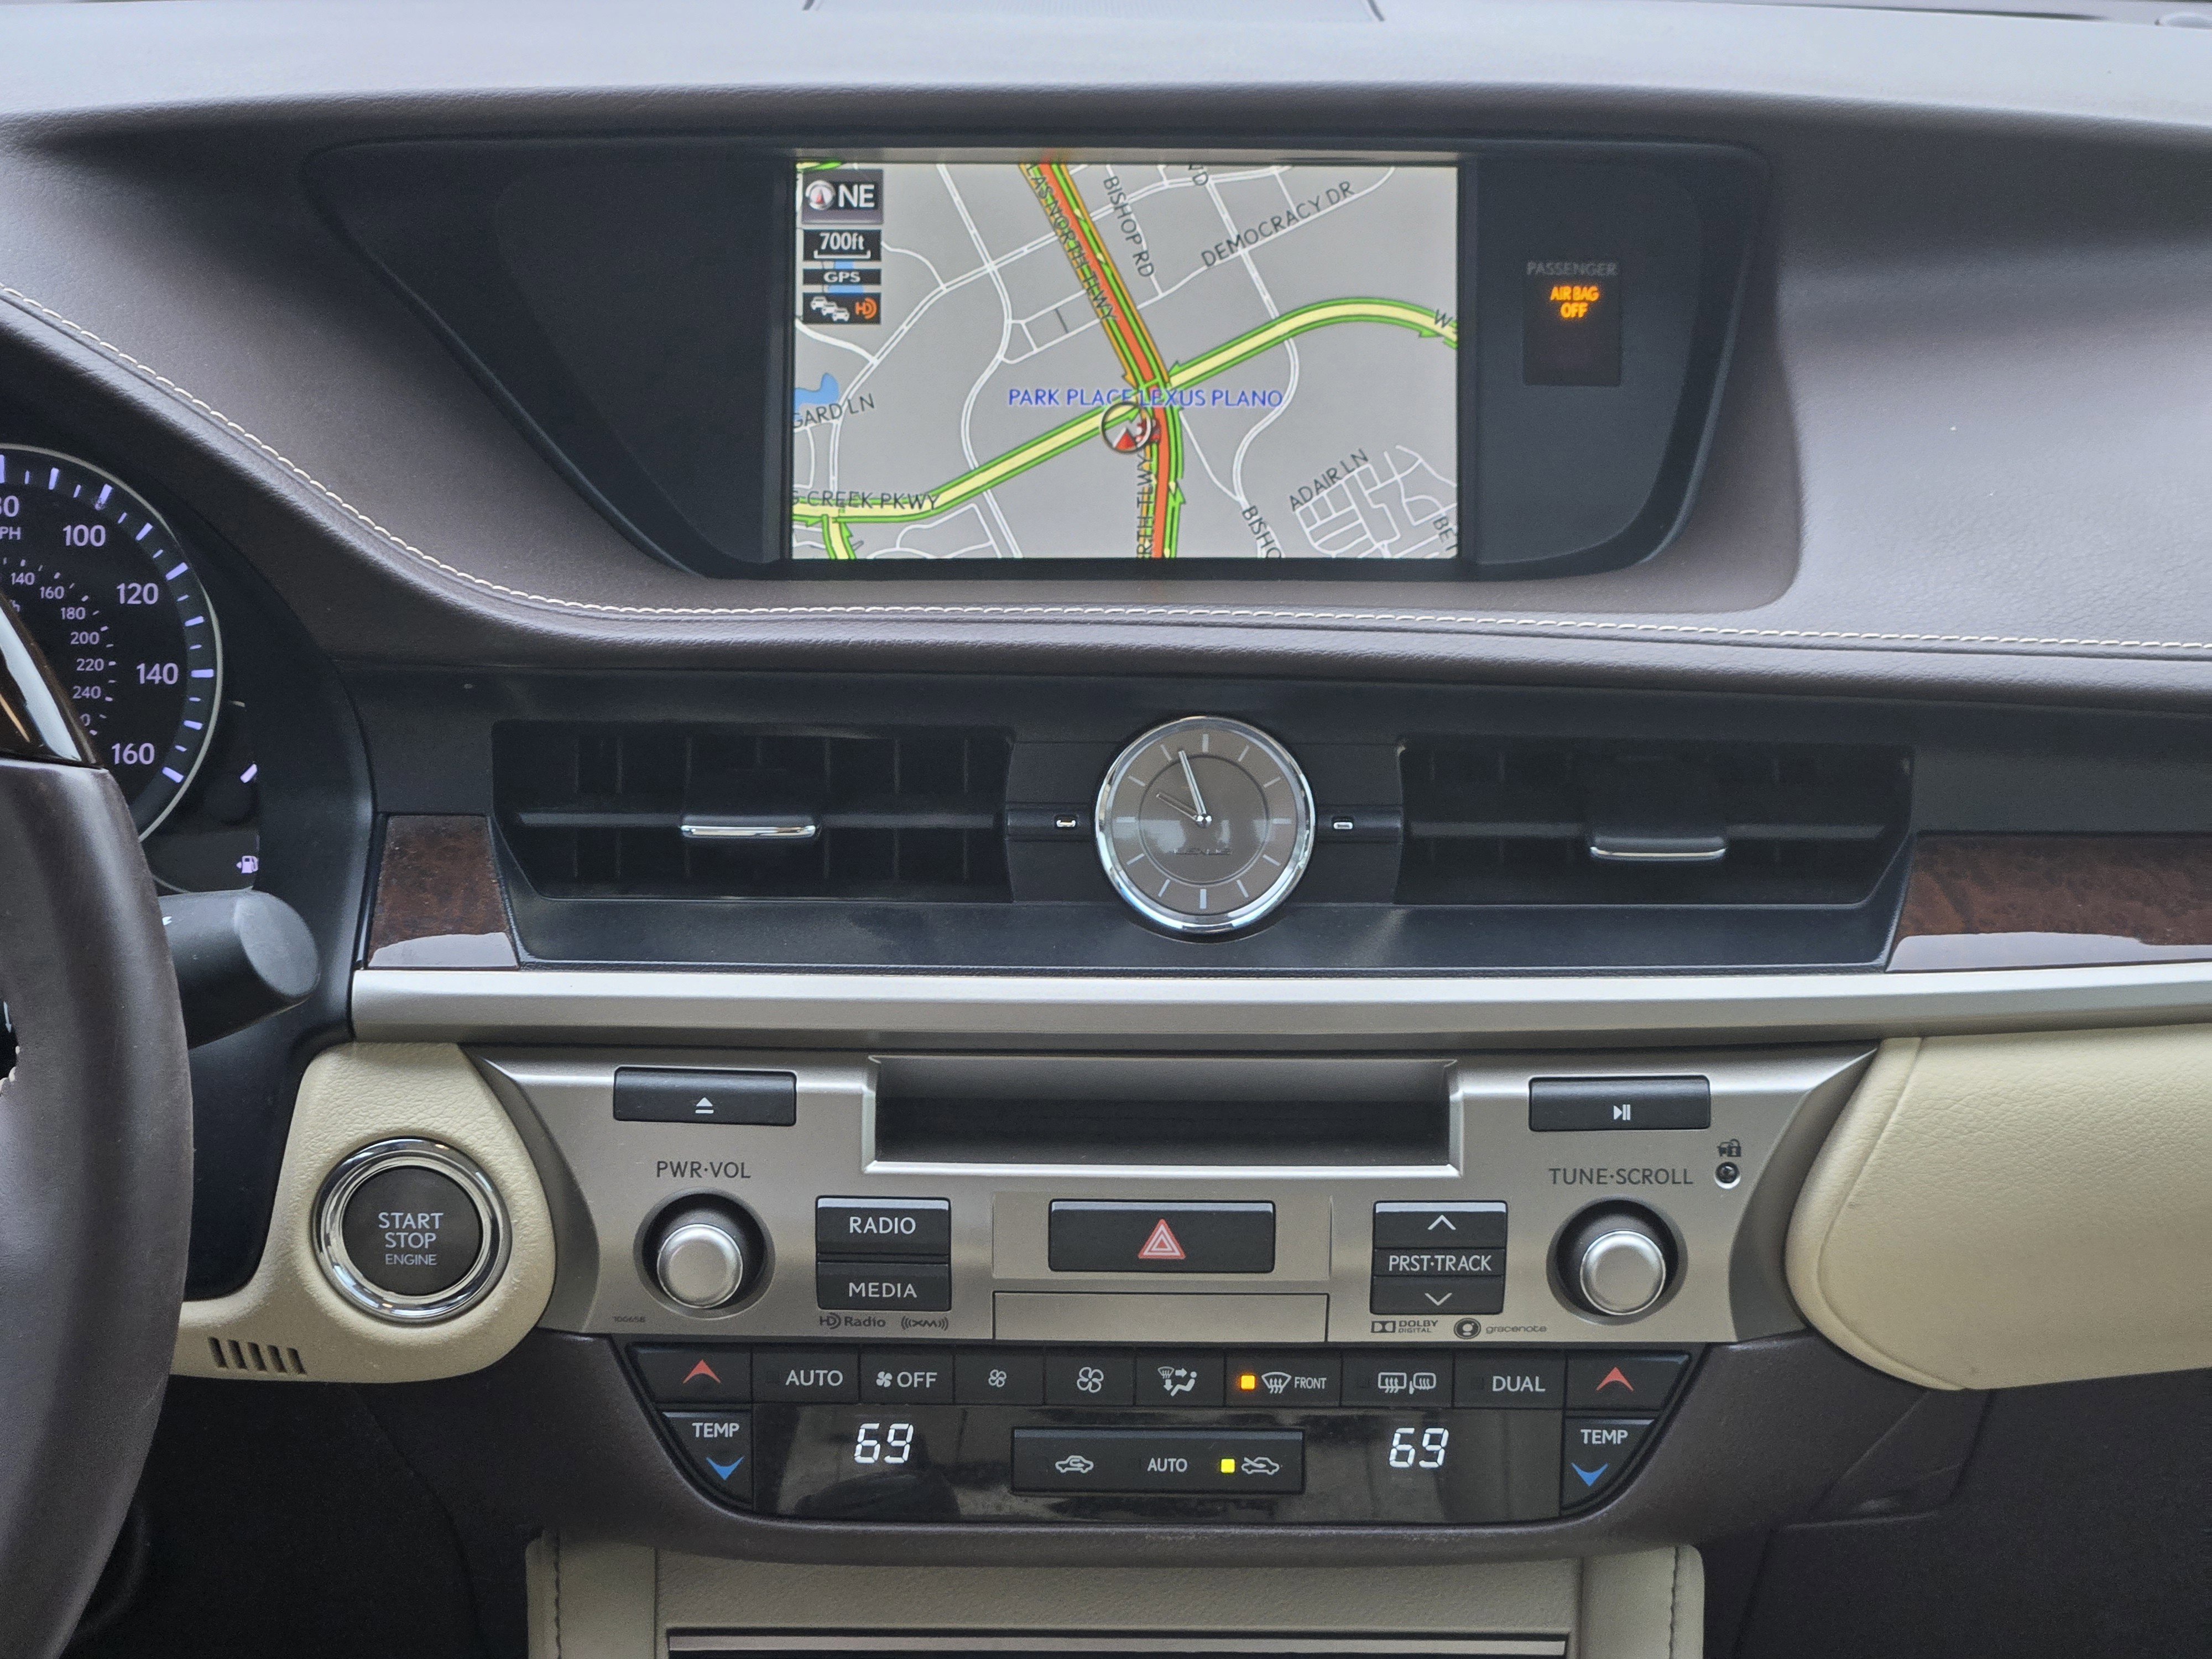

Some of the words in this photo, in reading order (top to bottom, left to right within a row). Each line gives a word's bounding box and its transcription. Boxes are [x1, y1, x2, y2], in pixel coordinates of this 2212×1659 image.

[838, 184, 875, 207] NE
[1103, 175, 1142, 247] BISHOP
[1133, 250, 1154, 277] RD
[1201, 195, 1323, 267] DEMOCRACY
[1326, 180, 1356, 206] DR
[820, 232, 864, 251] 700ft
[823, 271, 860, 283] GPS
[1526, 260, 1618, 278] PASSENGER
[1550, 285, 1572, 301] AIR
[1573, 285, 1600, 302] BAG
[1561, 302, 1588, 319] OFF
[847, 393, 875, 415] LN
[1008, 388, 1060, 406] PARK
[1066, 388, 1133, 406] PLACE
[1139, 388, 1206, 407] LEXUS
[1211, 388, 1284, 408] PLANO
[1288, 472, 1343, 513] ADAIR
[1340, 447, 1369, 477] LN
[0, 495, 19, 517] 0
[806, 491, 874, 509] CREEK
[879, 493, 941, 511] PKWY
[63, 524, 106, 547] 100
[11, 572, 35, 585] 140
[40, 586, 65, 599] 160
[117, 582, 159, 604] 120
[60, 607, 86, 620] 180
[70, 631, 100, 645] 200
[76, 658, 105, 671] 220
[137, 662, 179, 685] 140
[72, 685, 101, 699] 240
[112, 743, 155, 765] 160
[378, 1212, 444, 1229] START
[849, 1216, 916, 1234] RADIO
[385, 1232, 436, 1249] STOP
[385, 1253, 437, 1265] ENGINE
[849, 1282, 917, 1298] MEDIA
[844, 1316, 886, 1328] Radio
[1486, 1324, 1547, 1335] gracenote
[785, 1369, 843, 1386] AUTO
[897, 1371, 937, 1388] OFF
[1294, 1376, 1327, 1389] FRONT
[1492, 1376, 1546, 1392] DUAL
[692, 1422, 740, 1438] TEMP
[1580, 1429, 1628, 1444] TEMP
[854, 1423, 914, 1464] 69
[1389, 1427, 1449, 1468] 69
[1147, 1458, 1188, 1472] AUTO
